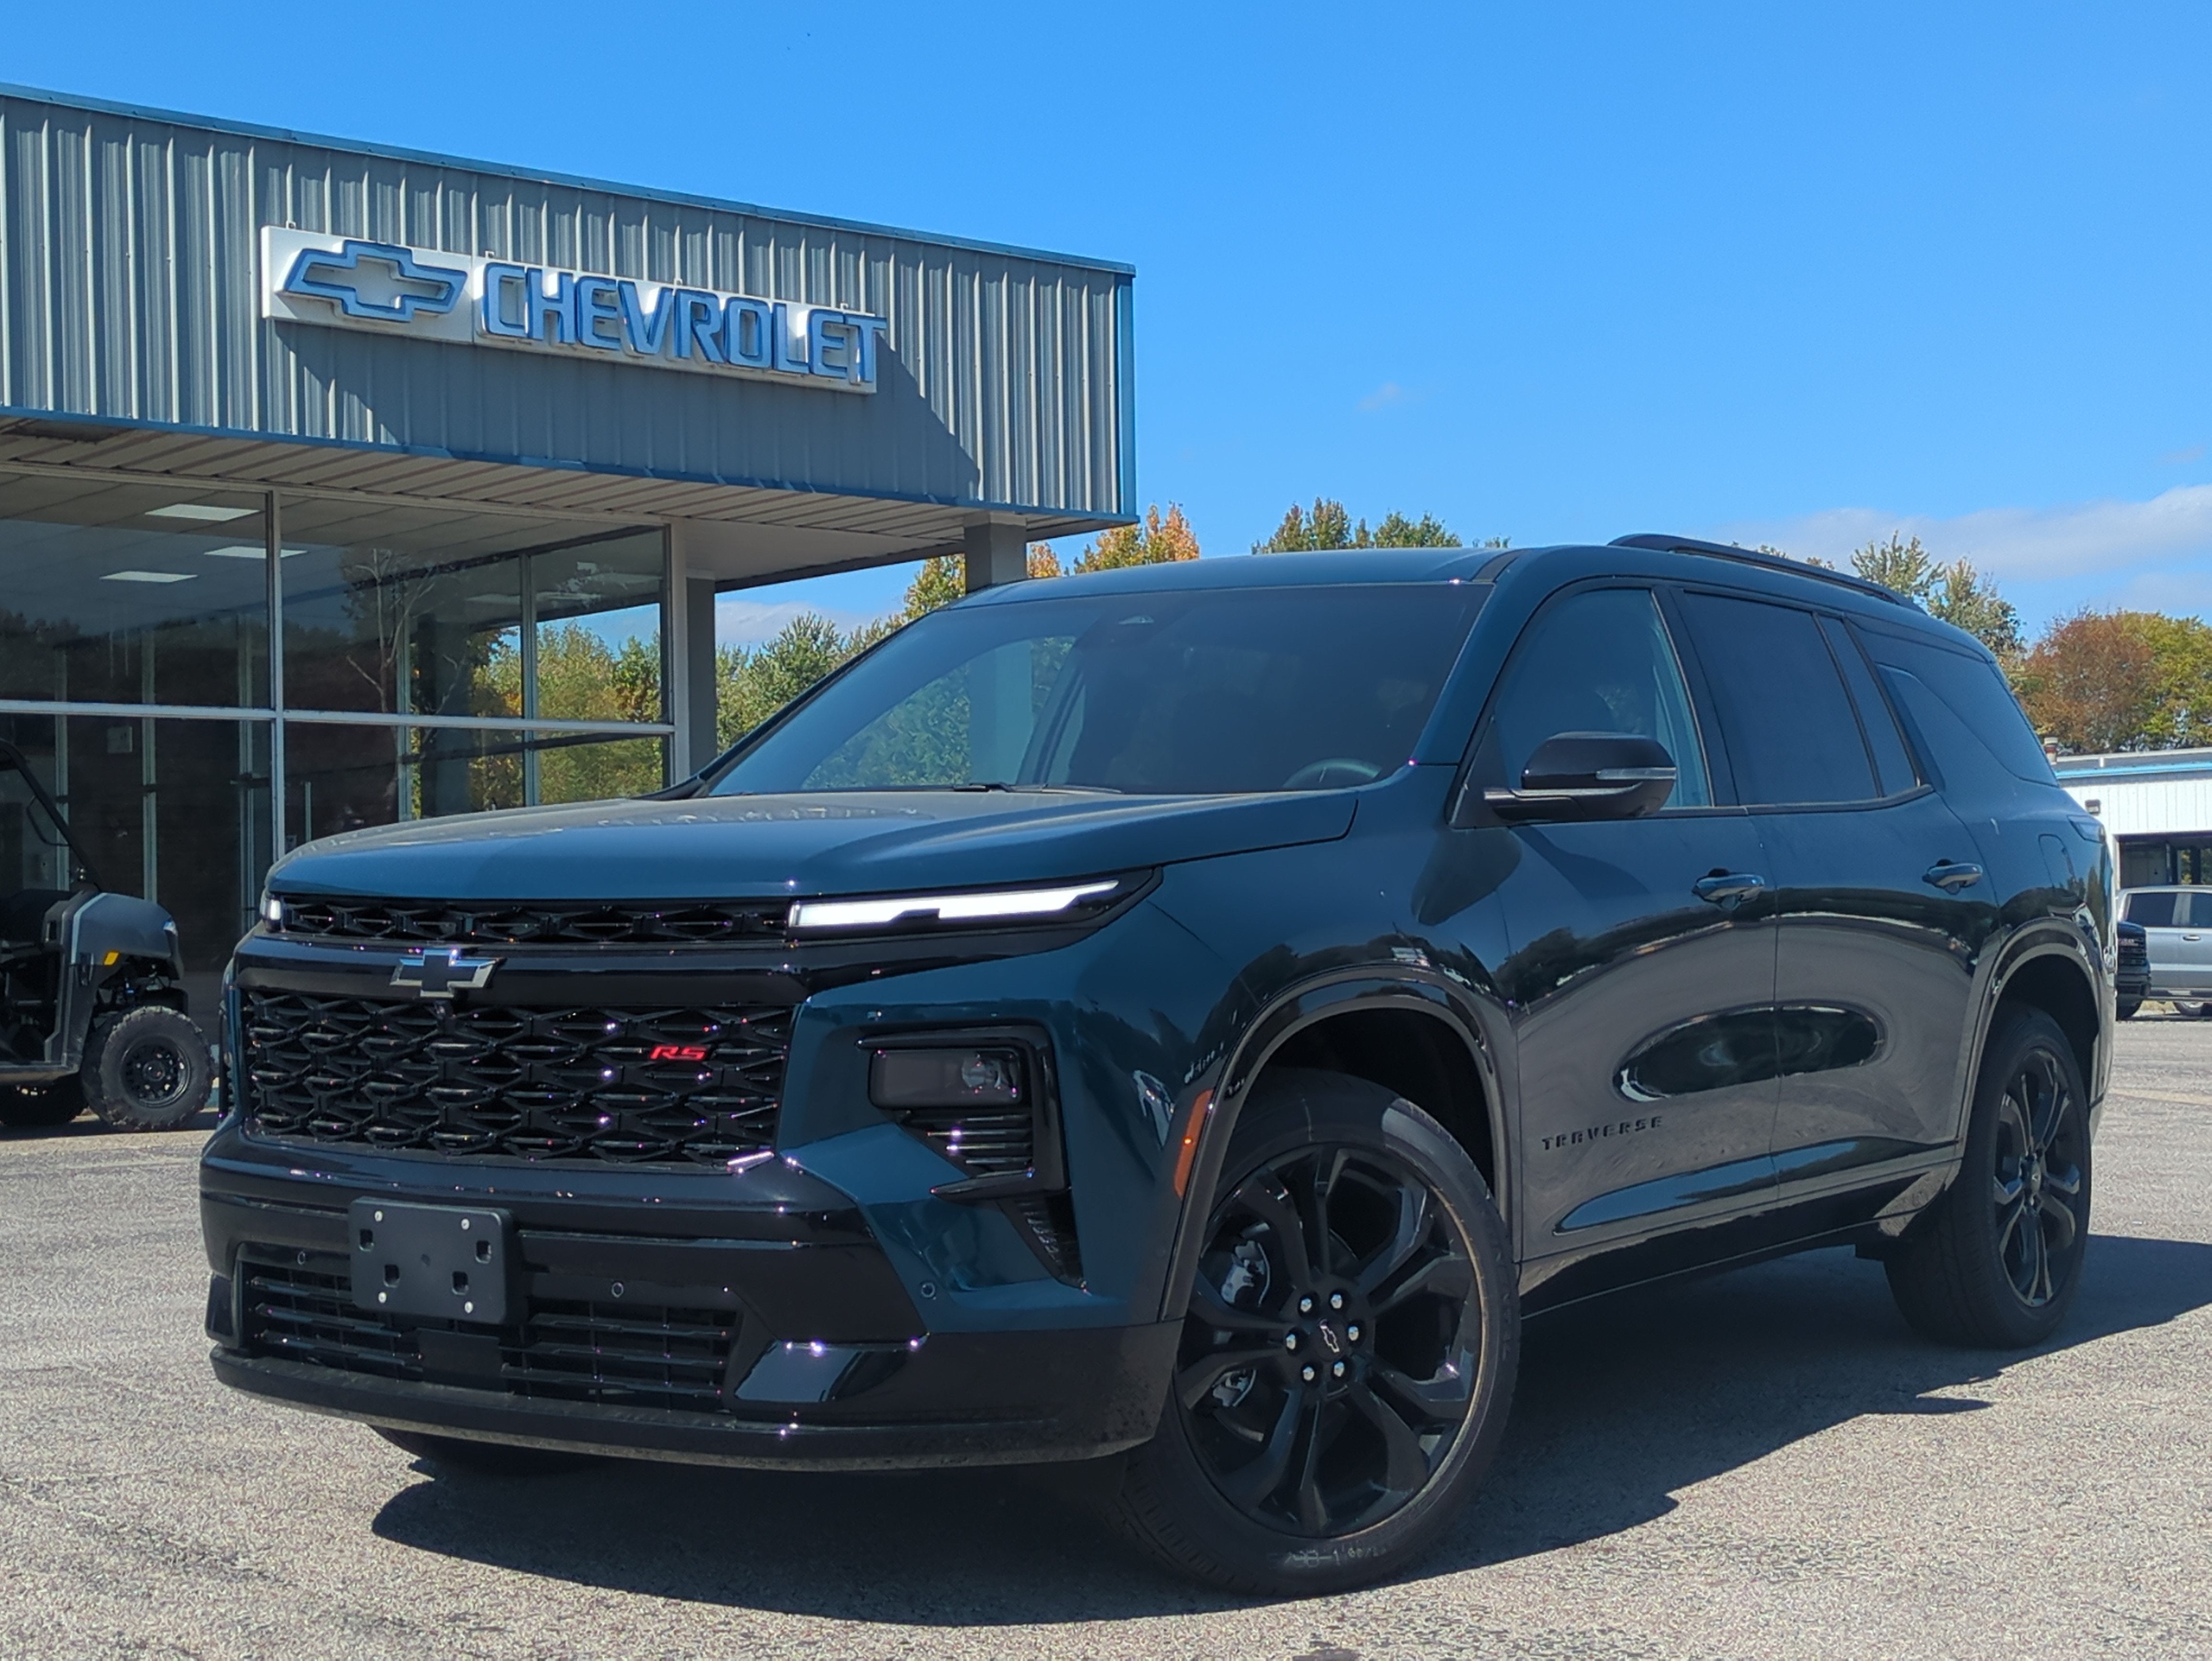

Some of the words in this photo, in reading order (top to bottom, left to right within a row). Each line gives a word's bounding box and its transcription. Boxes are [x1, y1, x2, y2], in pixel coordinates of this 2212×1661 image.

[483, 262, 887, 383] CHEVROLET
[649, 1045, 707, 1060] RS
[1541, 1116, 1662, 1150] TRAVERSE
